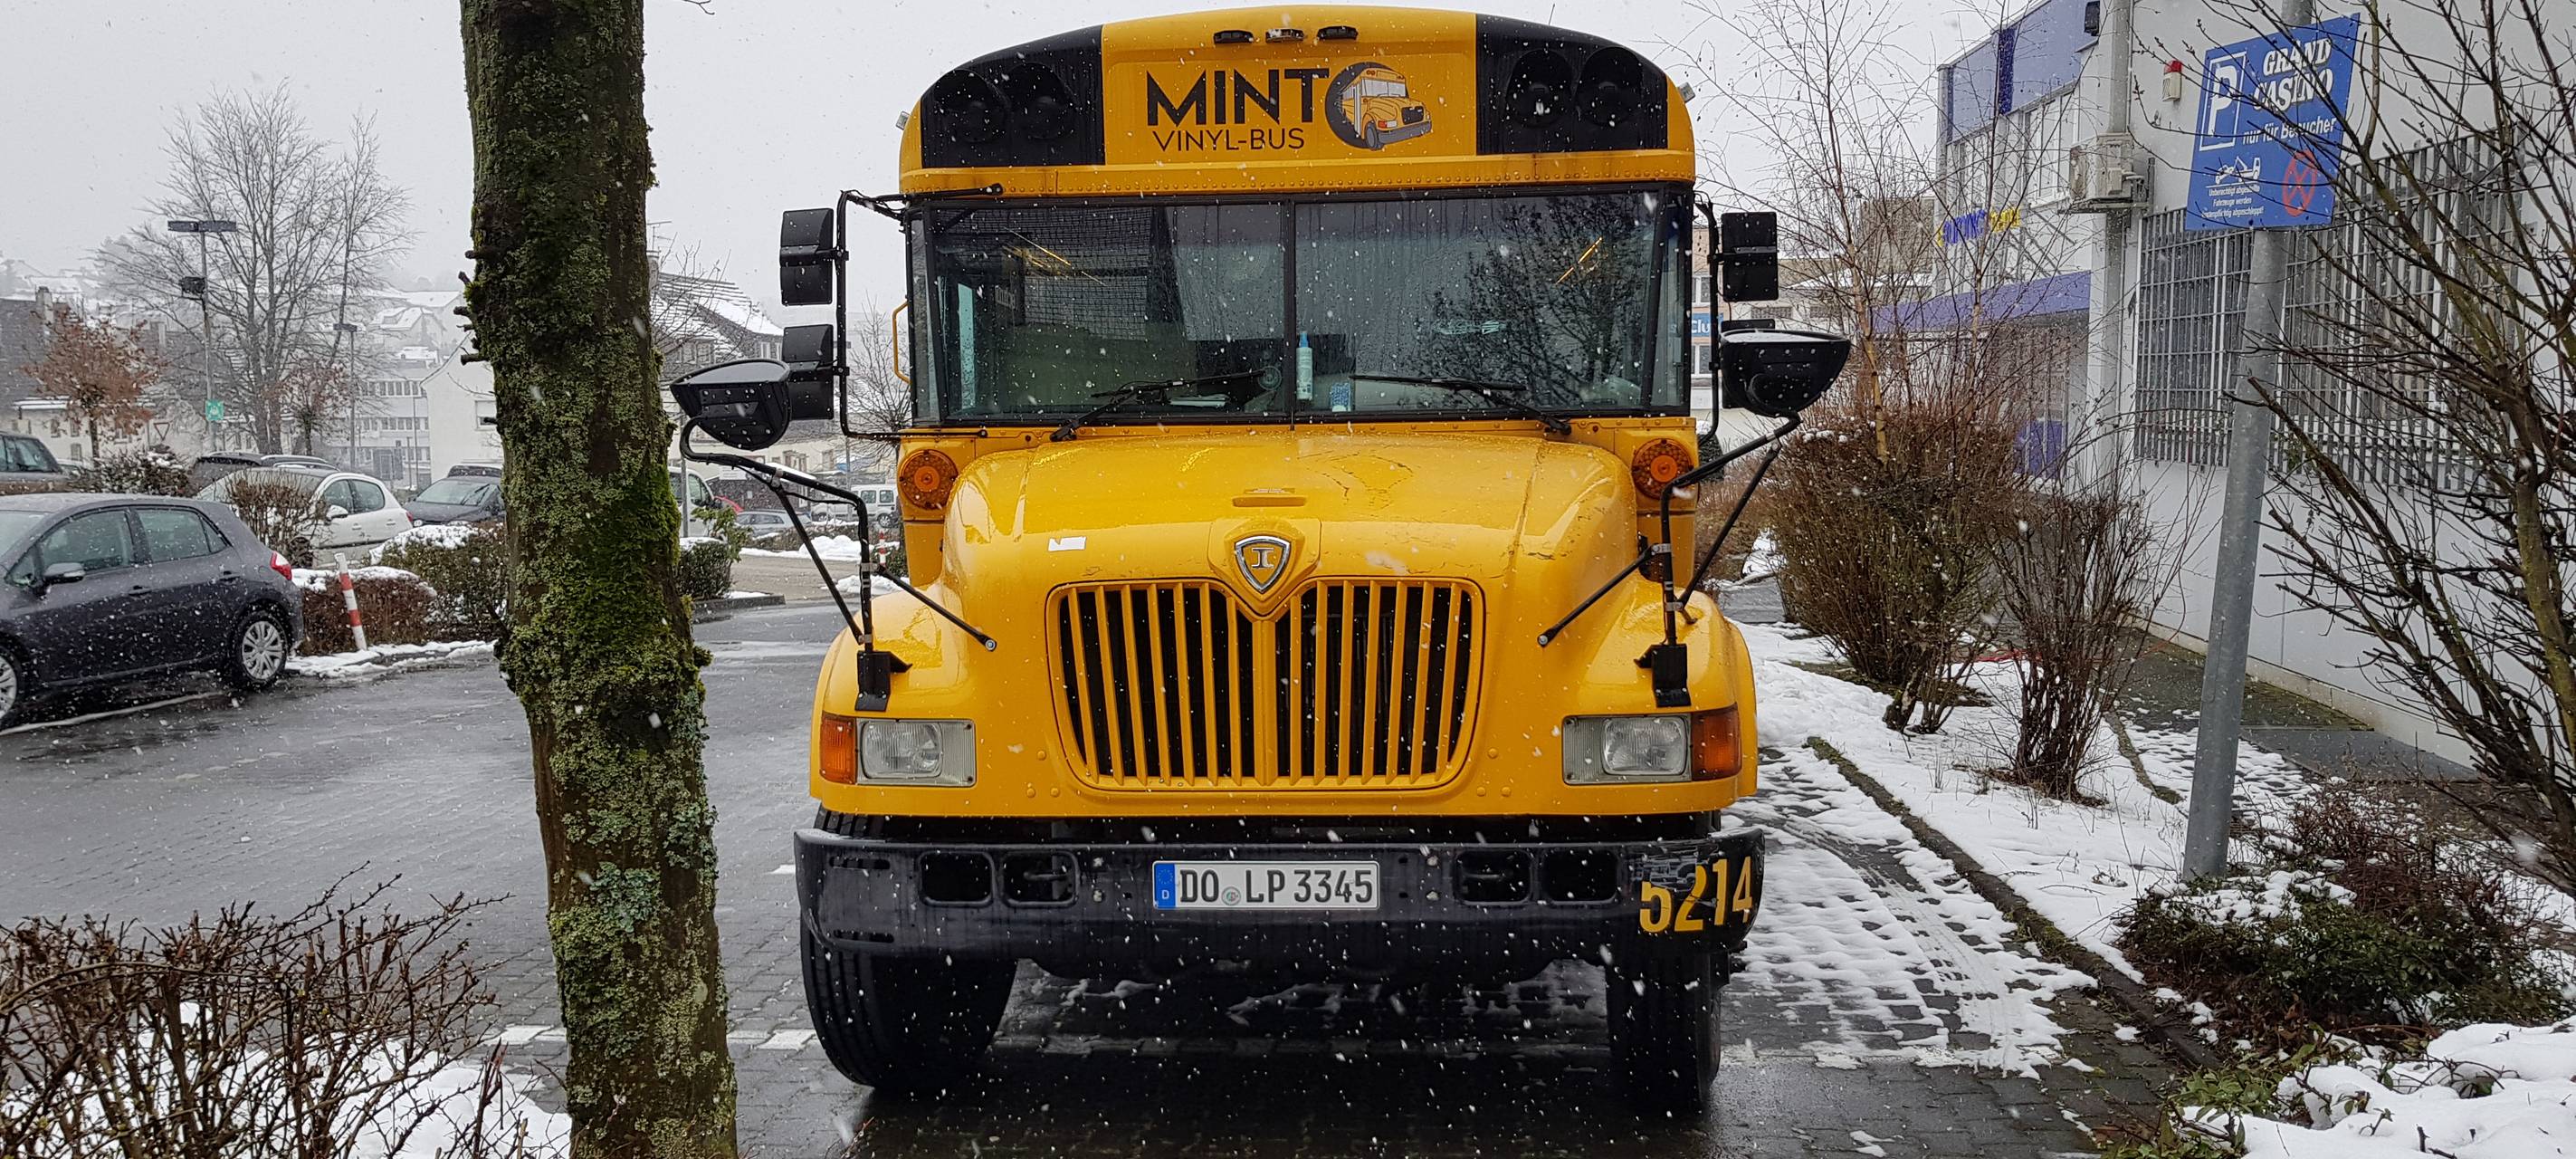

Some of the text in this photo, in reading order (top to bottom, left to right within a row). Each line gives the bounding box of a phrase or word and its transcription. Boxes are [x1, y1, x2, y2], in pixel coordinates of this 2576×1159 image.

[2264, 38, 2332, 76] GRAND
[2254, 69, 2333, 111] CASINO
[1152, 128, 1304, 151] VINYL-BUS
[2243, 129, 2263, 145] nur
[2263, 121, 2279, 142] für
[1161, 888, 1170, 900] D
[1180, 869, 1373, 903] DO LP 3345
[1639, 856, 1753, 933] 5214
